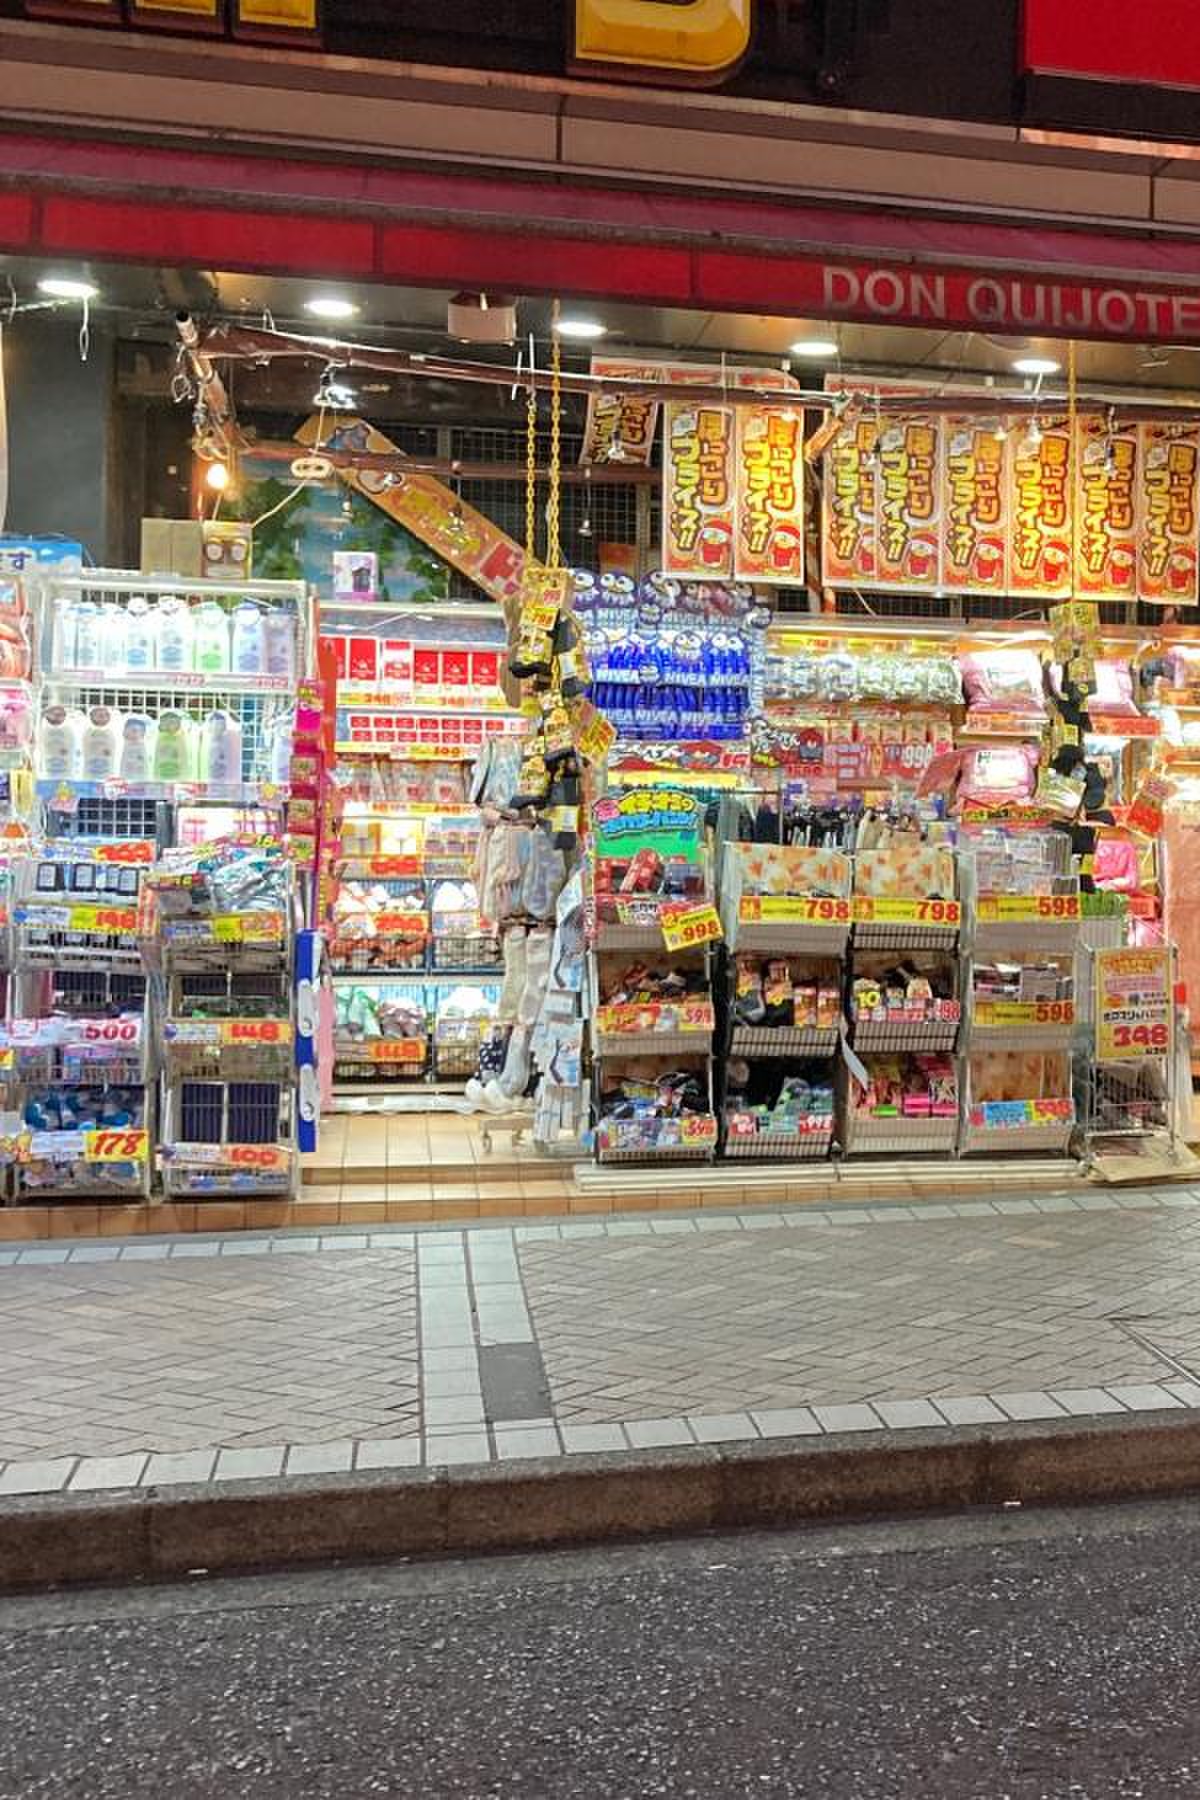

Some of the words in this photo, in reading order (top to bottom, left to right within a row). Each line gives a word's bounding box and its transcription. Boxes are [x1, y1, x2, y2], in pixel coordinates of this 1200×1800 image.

[821, 266, 945, 319] DON
[966, 278, 1200, 337] QUIJOTE
[664, 673, 706, 685] NIVEA
[803, 900, 849, 919] 798
[915, 901, 959, 921] 798
[1038, 896, 1079, 916] 598
[682, 919, 718, 941] 998
[1035, 1003, 1074, 1021] 598
[85, 1022, 137, 1041] 500
[93, 1132, 146, 1157] 178
